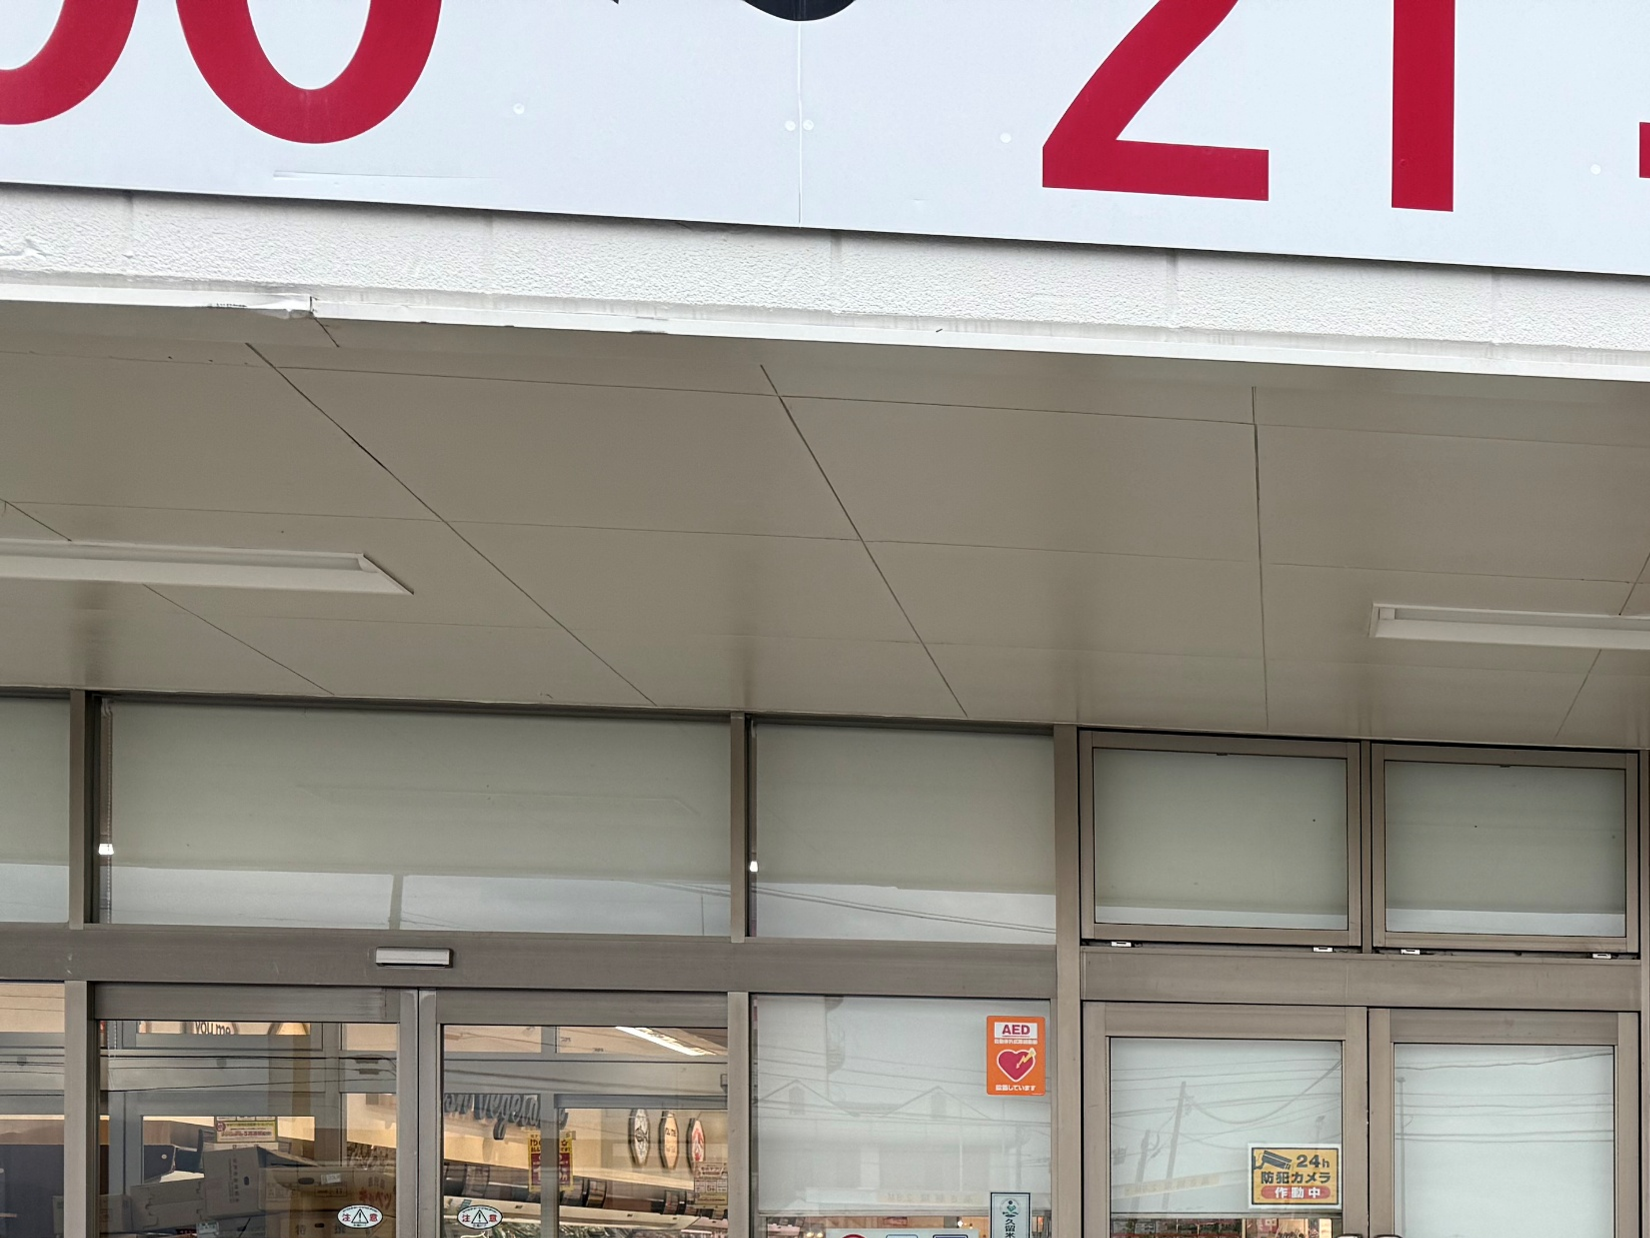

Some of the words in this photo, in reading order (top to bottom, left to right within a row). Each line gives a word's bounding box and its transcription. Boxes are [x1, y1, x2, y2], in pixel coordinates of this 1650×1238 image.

[1002, 1024, 1030, 1035] AED
[1296, 1154, 1330, 1168] 24h
[1261, 1171, 1331, 1184] 防犯カメラ
[1275, 1186, 1320, 1199] 作動中
